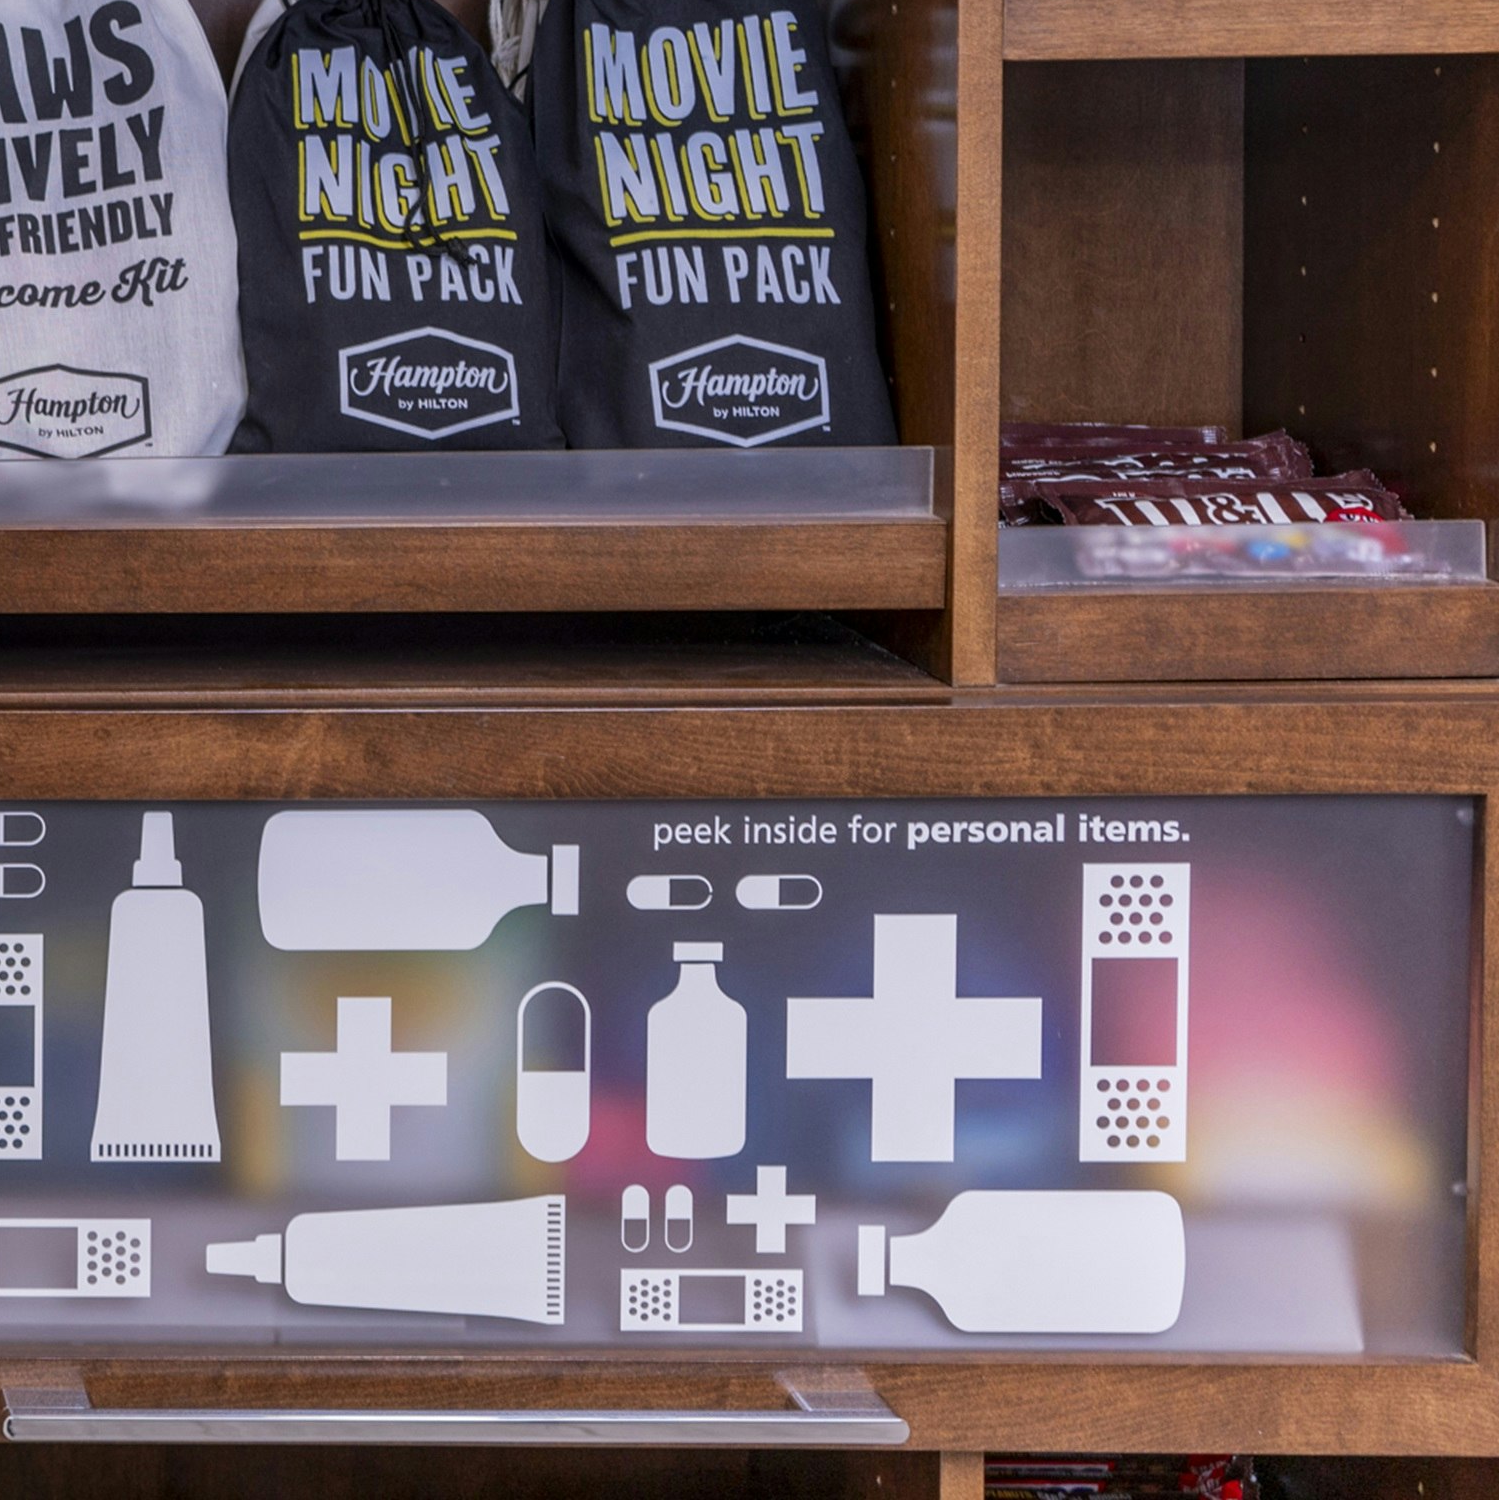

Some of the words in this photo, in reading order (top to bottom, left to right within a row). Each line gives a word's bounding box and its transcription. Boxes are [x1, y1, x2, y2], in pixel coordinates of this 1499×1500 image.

[584, 10, 820, 127] MOVIE
[292, 45, 493, 145] MOVIE
[299, 134, 511, 234] NIGHT
[594, 121, 826, 228] NIGHT
[111, 257, 188, 307] Kit
[302, 245, 391, 304] FUN
[407, 244, 523, 305] PACK
[615, 245, 708, 310] FUN
[723, 244, 842, 305] PACK
[350, 355, 509, 396] Hampton
[662, 366, 819, 408] Hampton
[398, 398, 414, 411] by
[418, 398, 469, 410] HILTON
[713, 406, 729, 420] by
[733, 405, 780, 418] HILTON
[38, 428, 52, 440] by
[55, 425, 104, 439] HILTON
[653, 816, 732, 851] peek
[743, 816, 838, 845] inside
[848, 815, 897, 843] for
[907, 814, 1065, 849] personal
[1079, 814, 1190, 843] items.
